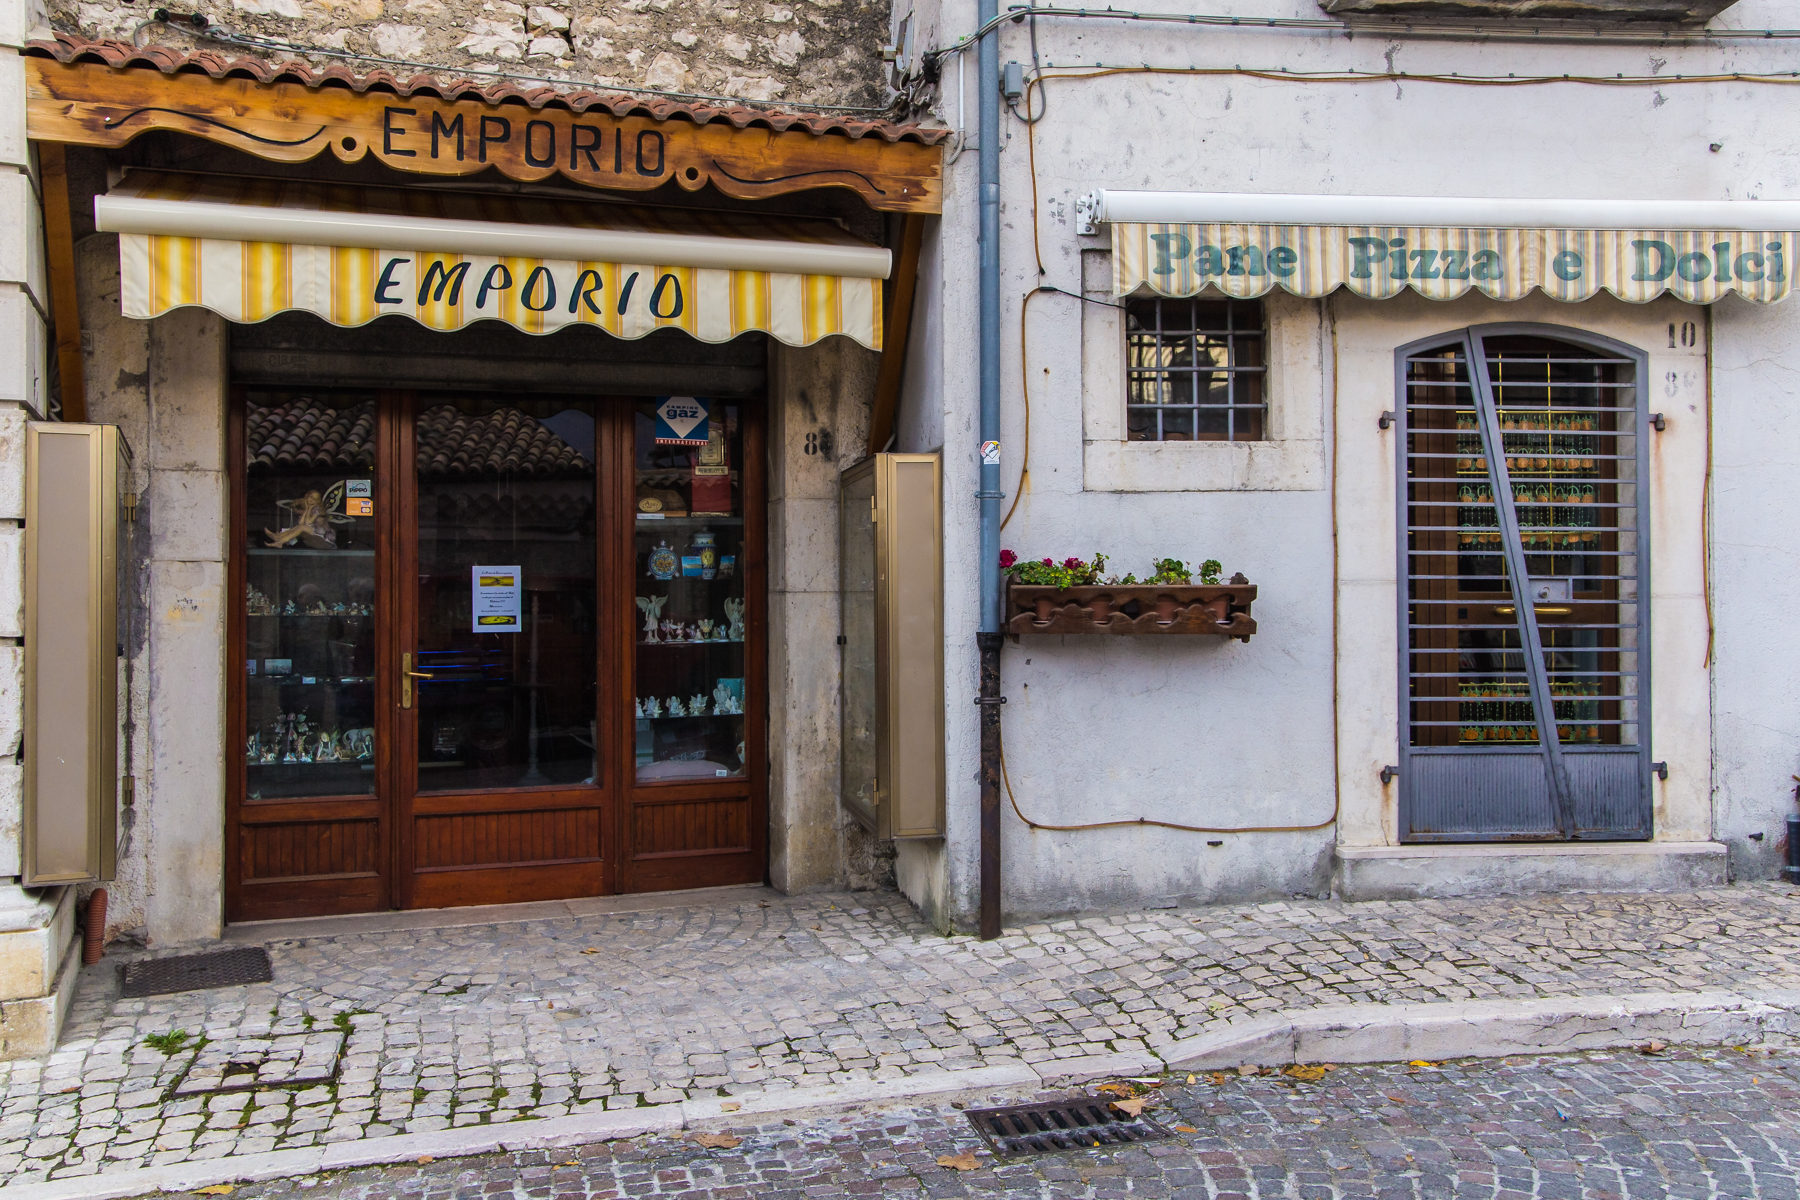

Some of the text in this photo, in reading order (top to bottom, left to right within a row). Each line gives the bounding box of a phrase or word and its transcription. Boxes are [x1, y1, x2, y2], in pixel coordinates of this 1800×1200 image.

[384, 105, 666, 177] EMPORIO
[1150, 232, 1786, 283] Pane Pizza e Dolci
[374, 257, 684, 319] EMPORIO
[1667, 321, 1696, 349] 10
[666, 409, 699, 420] gaz
